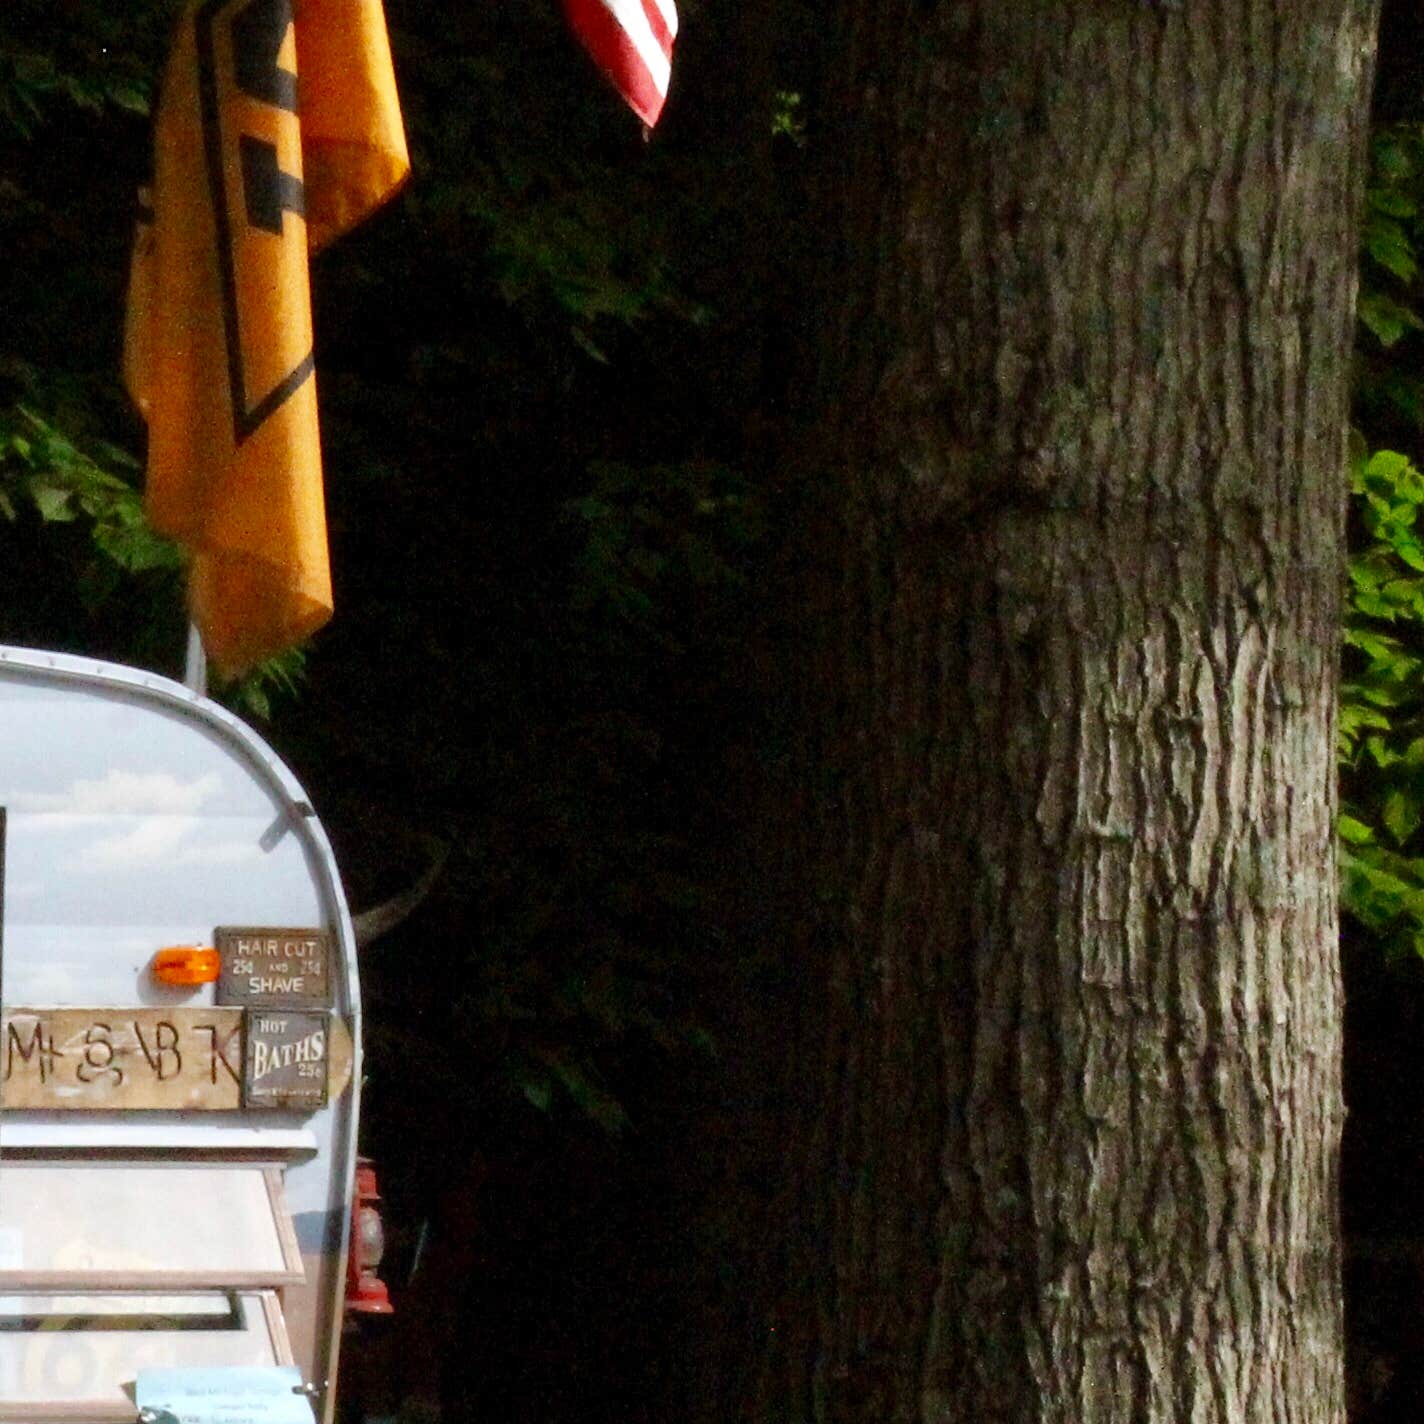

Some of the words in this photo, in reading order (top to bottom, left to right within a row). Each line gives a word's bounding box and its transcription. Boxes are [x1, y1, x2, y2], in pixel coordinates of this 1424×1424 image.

[238, 940, 278, 956] HAIR
[284, 941, 317, 957] CUT
[269, 963, 289, 973] AND
[248, 977, 304, 994] SHAVE
[260, 1020, 288, 1033] HOT
[253, 1031, 324, 1080] BATHS
